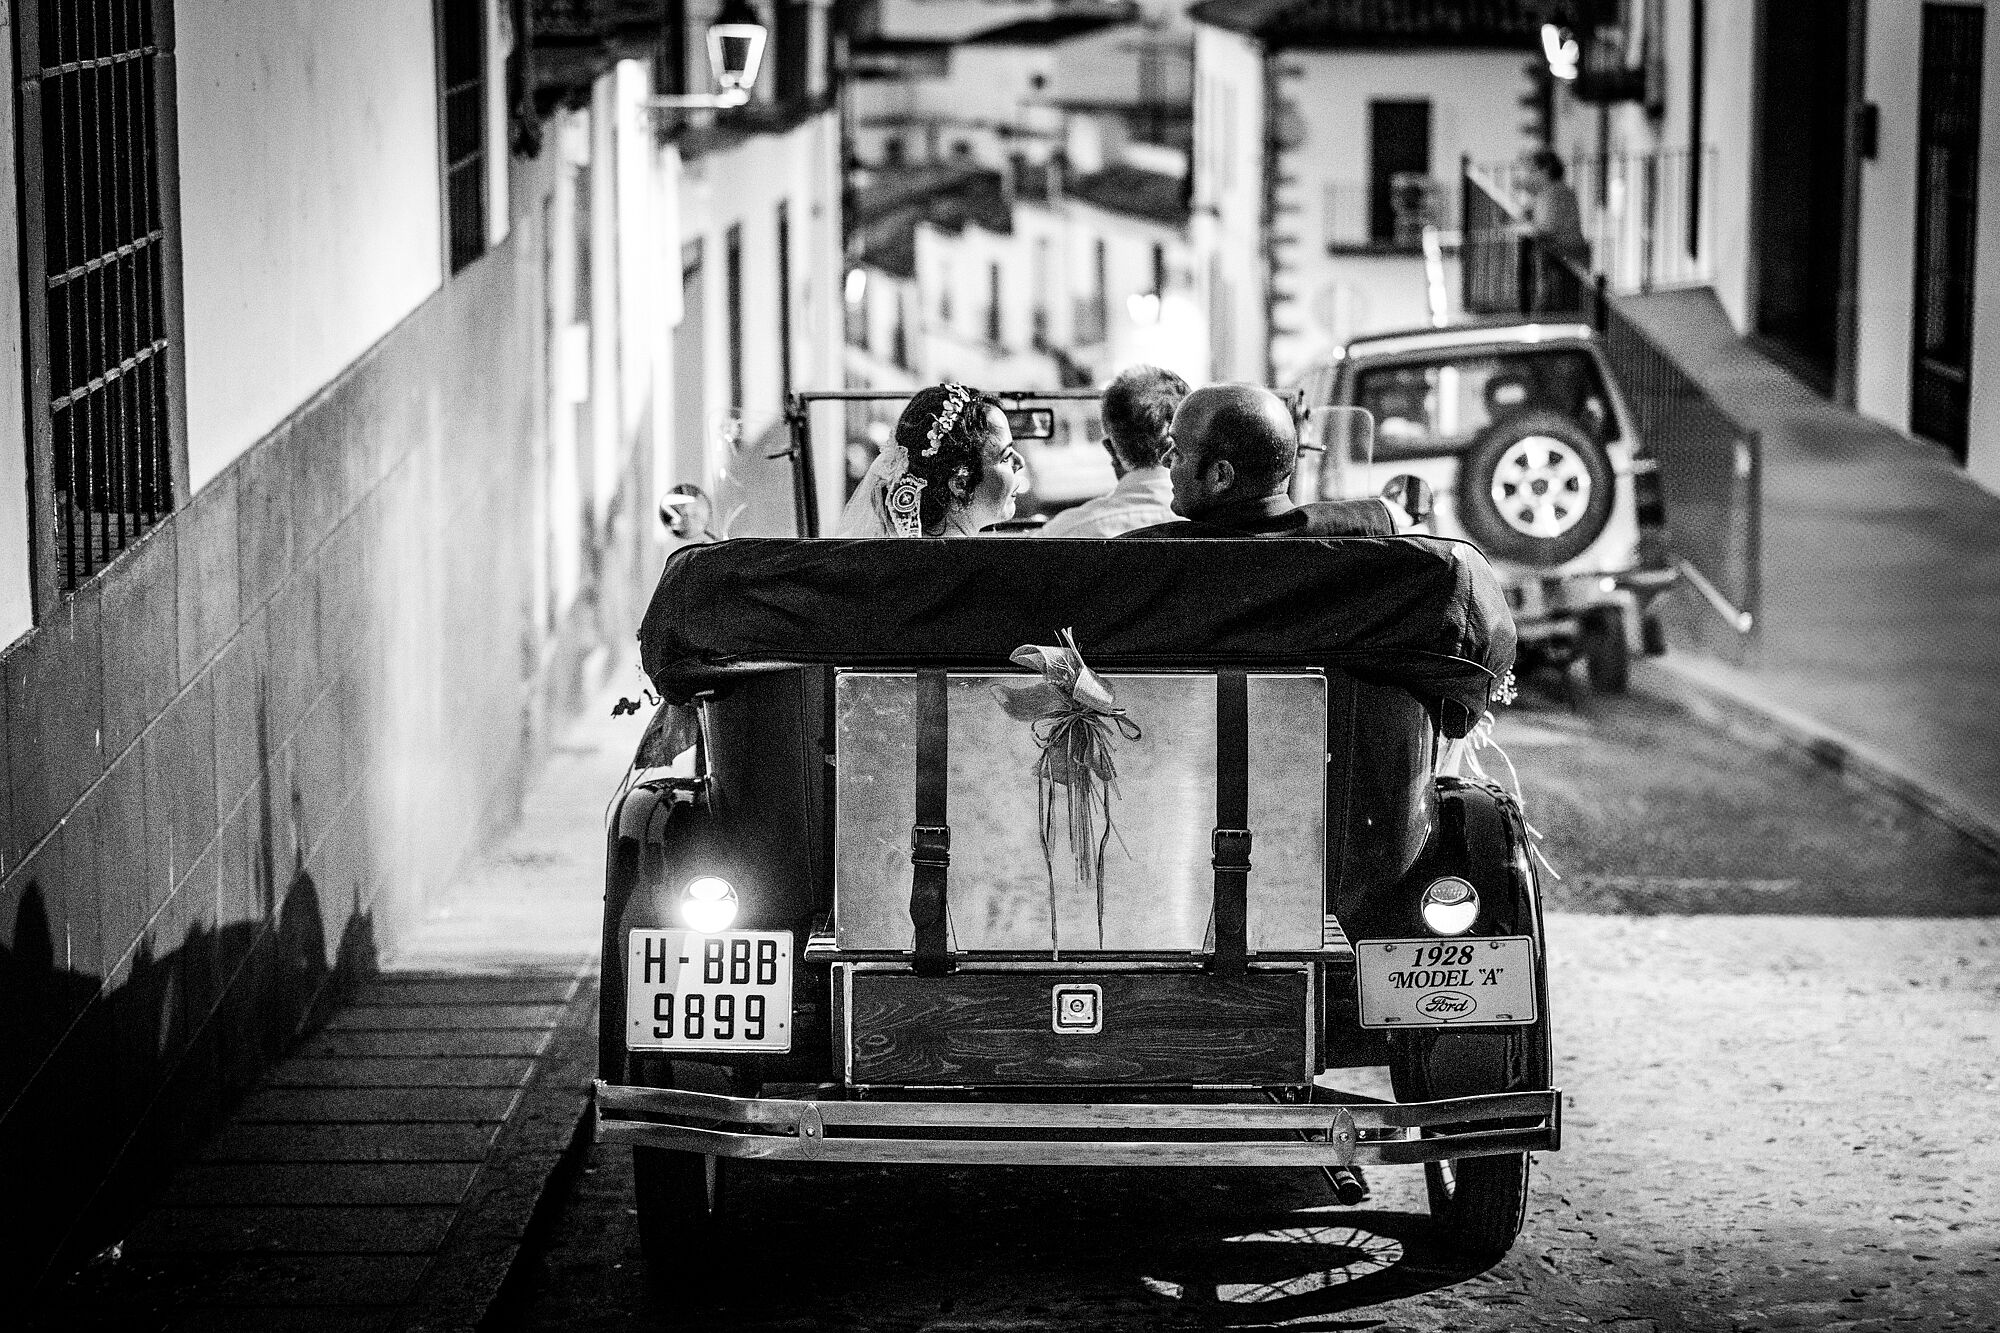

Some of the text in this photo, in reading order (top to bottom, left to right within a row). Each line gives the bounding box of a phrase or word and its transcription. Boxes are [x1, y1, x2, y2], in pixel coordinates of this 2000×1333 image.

[1411, 945, 1475, 968] 1928
[1388, 969, 1475, 989] MODEL
[1425, 995, 1469, 1012] Ford
[652, 992, 766, 1041] 9899
